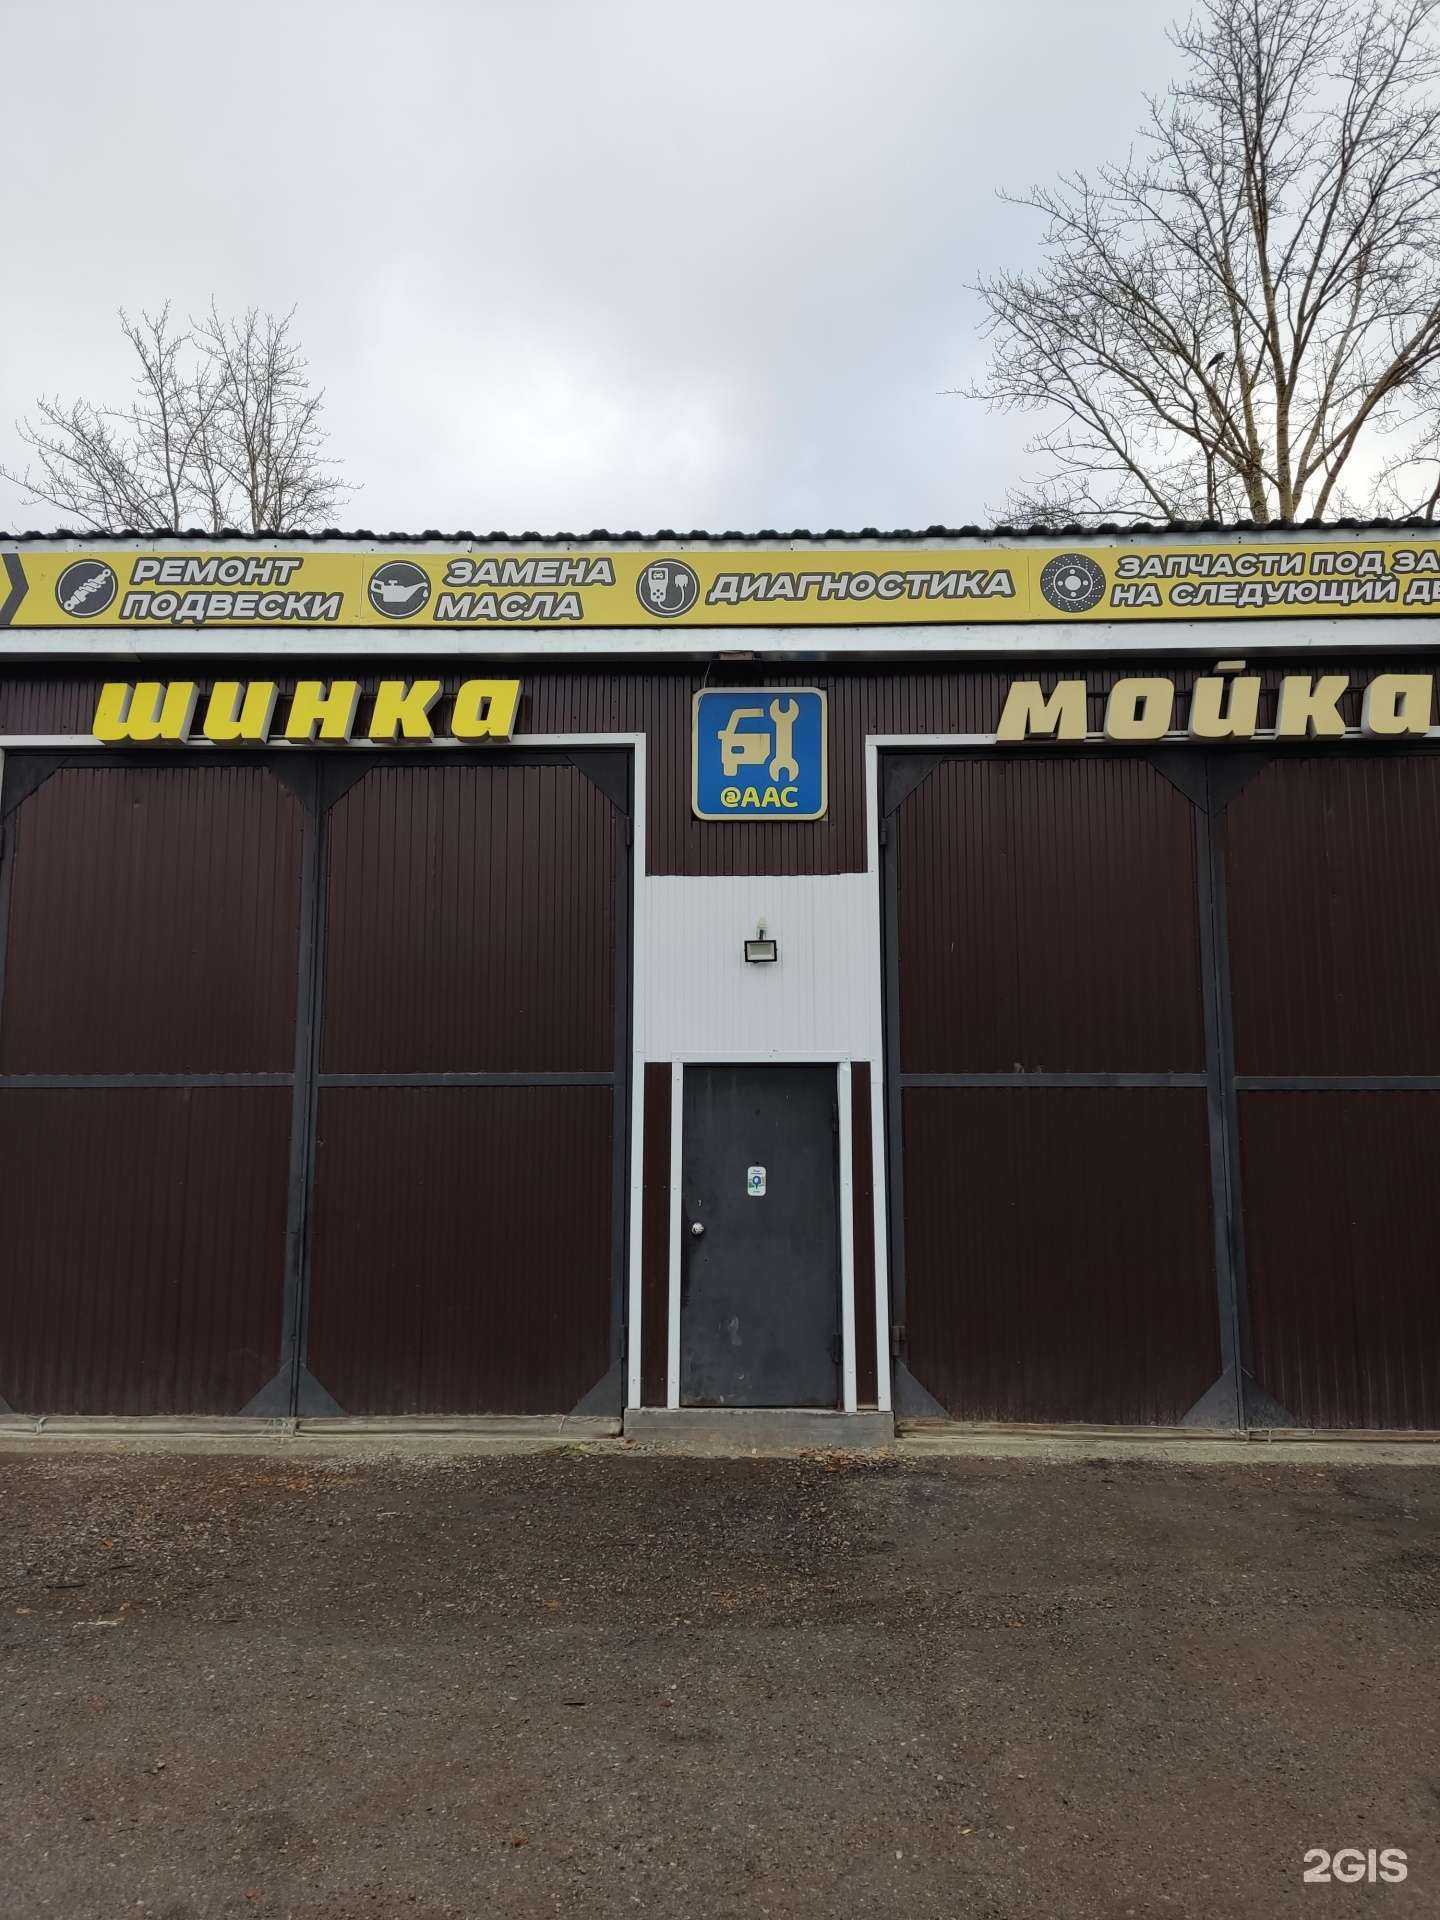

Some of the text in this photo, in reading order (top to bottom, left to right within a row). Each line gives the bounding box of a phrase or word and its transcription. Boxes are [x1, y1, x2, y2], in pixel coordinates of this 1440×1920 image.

[133, 559, 301, 583] РЕМОНТ
[446, 559, 613, 584] ЗАМЕНА
[1119, 554, 1303, 577] ЗАПЧАСТИ
[1312, 552, 1383, 575] ПОД
[708, 572, 1012, 602] ДИАГНОСТИКА
[1113, 585, 1158, 605] НА
[1171, 575, 1398, 606] СЛЕДУЮЩИЙ
[122, 593, 340, 621] ПОДВЕСКИ
[436, 594, 581, 618] МАСЛА
